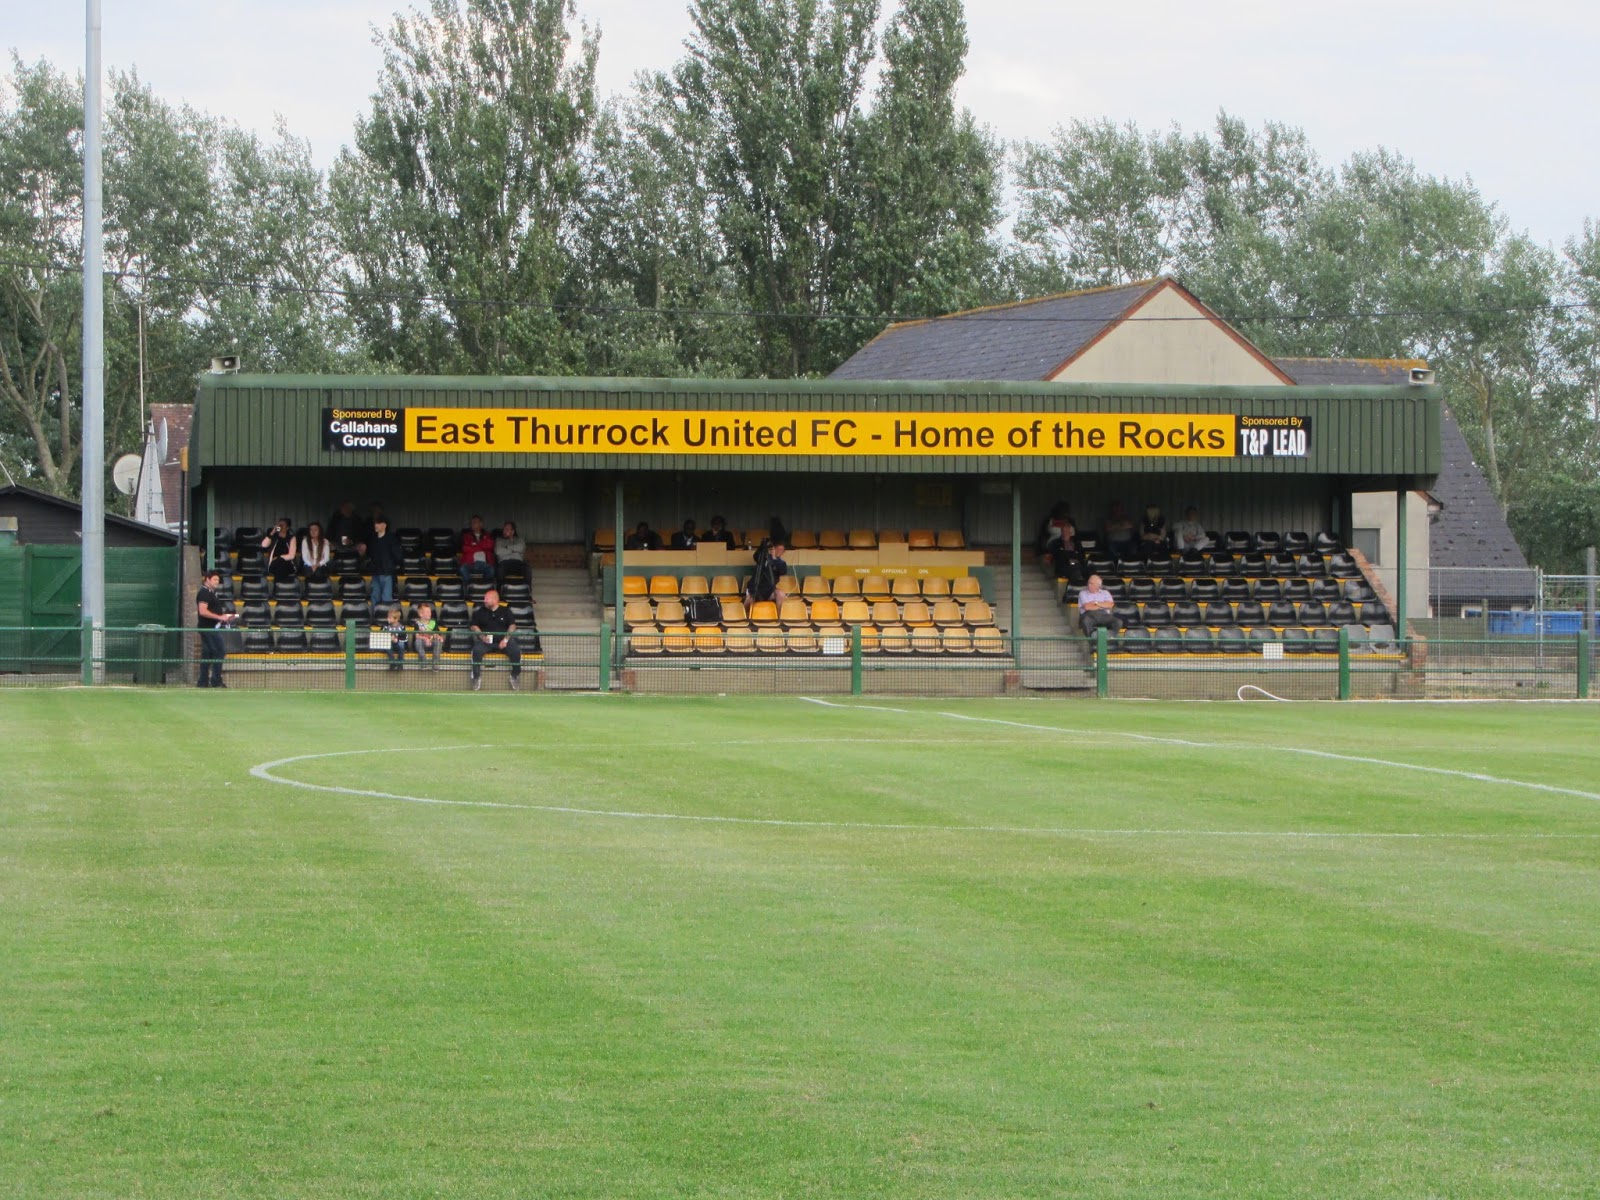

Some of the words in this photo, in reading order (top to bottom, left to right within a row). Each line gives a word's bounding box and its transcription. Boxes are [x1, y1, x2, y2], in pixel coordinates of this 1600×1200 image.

[332, 408, 382, 420] Sponsored
[384, 409, 397, 420] By
[330, 421, 398, 434] Callahans
[1241, 416, 1288, 427] Sponsored
[1290, 416, 1303, 428] By
[417, 416, 495, 445] East
[507, 417, 669, 446] Thurrock
[684, 418, 797, 447] United
[812, 420, 857, 448] FC
[895, 421, 994, 448] Home
[1008, 421, 1043, 448] of
[1053, 421, 1106, 449] the
[1120, 422, 1225, 450] Rocks
[342, 434, 386, 449] Group
[1240, 428, 1269, 456] T&P
[1272, 428, 1307, 456] LEAD
